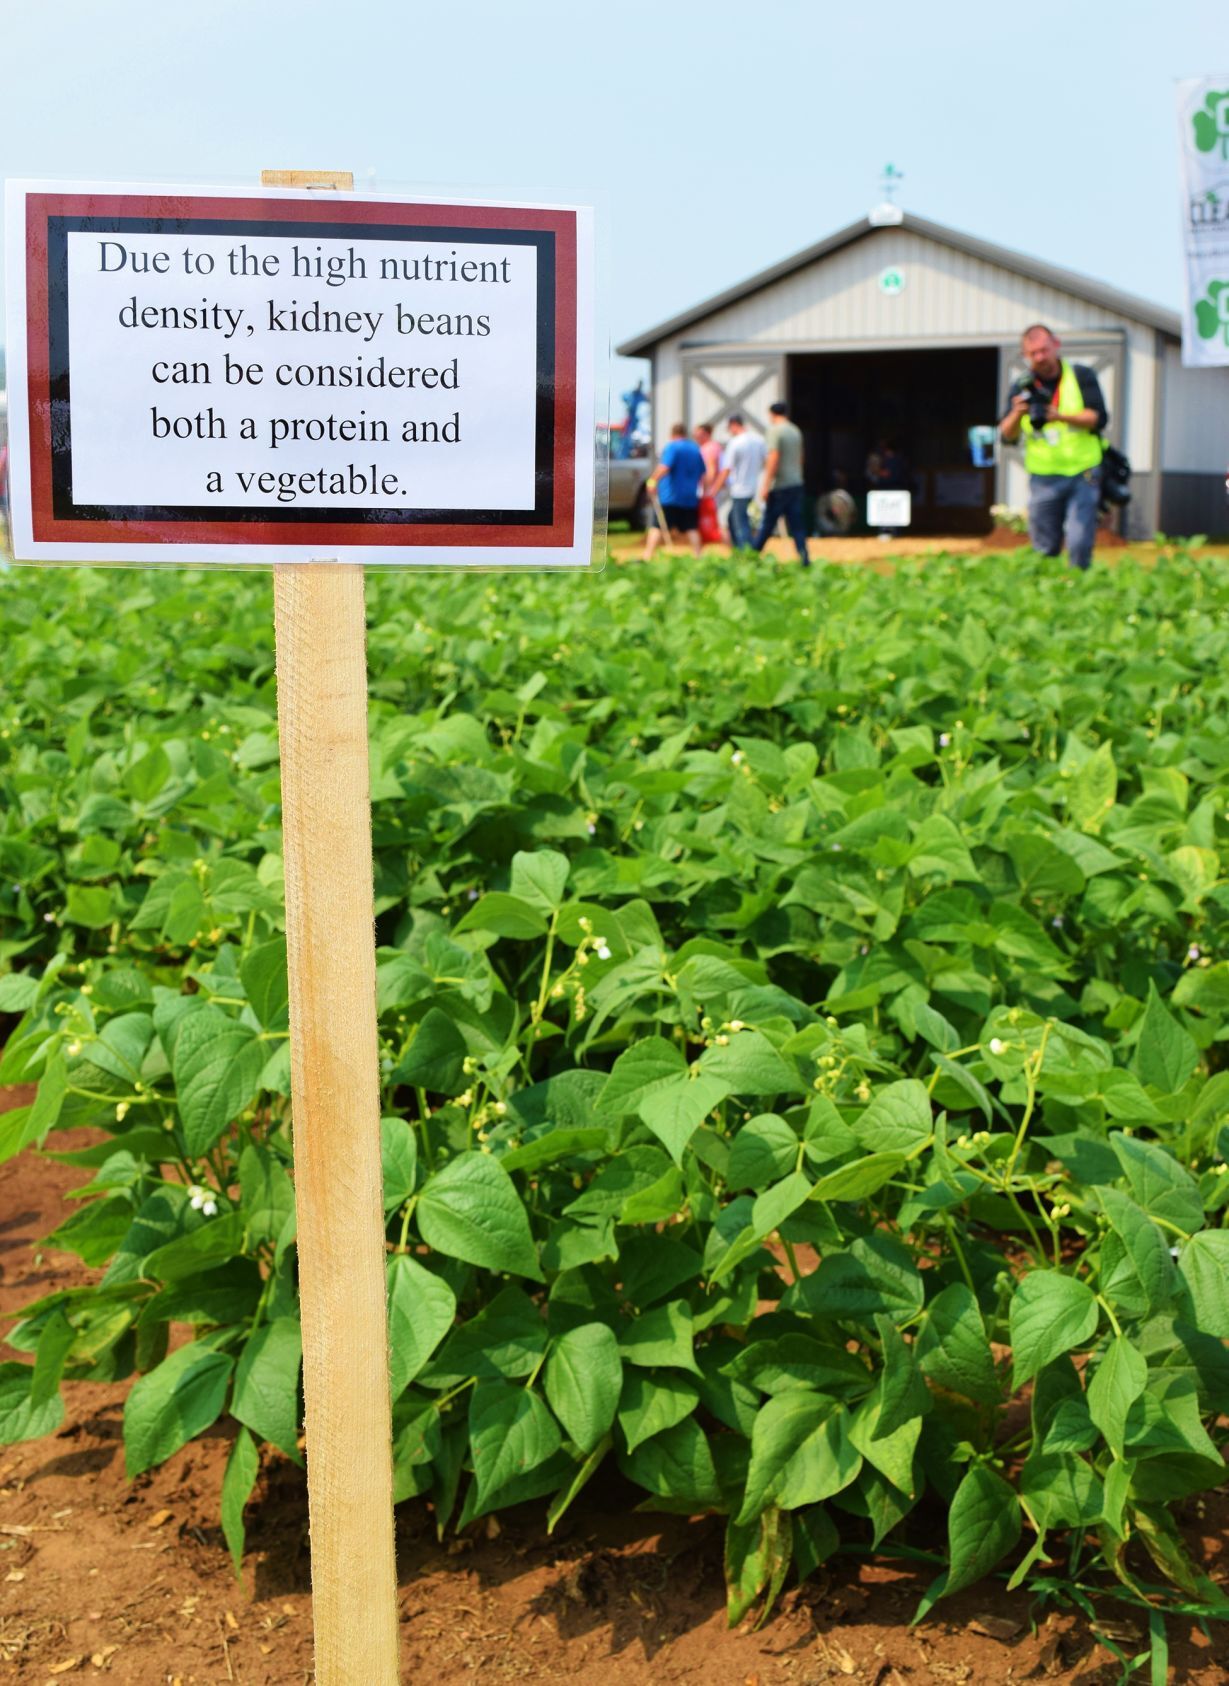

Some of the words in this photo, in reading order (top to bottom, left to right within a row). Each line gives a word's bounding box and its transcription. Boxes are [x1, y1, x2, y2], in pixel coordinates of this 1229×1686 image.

[98, 241, 170, 274] Due
[183, 247, 215, 275] to
[228, 245, 280, 277] the
[292, 246, 368, 287] high
[381, 251, 511, 284] nutrient
[119, 297, 255, 339] density,
[268, 300, 384, 342] kidney
[396, 303, 491, 337] beans
[152, 362, 212, 384] can
[224, 353, 264, 386] be
[276, 356, 461, 390] considered
[151, 407, 228, 439] both
[240, 418, 258, 440] a
[269, 411, 391, 449] protein
[402, 412, 462, 443] and
[207, 472, 225, 493] a
[236, 464, 407, 503] vegetable.
